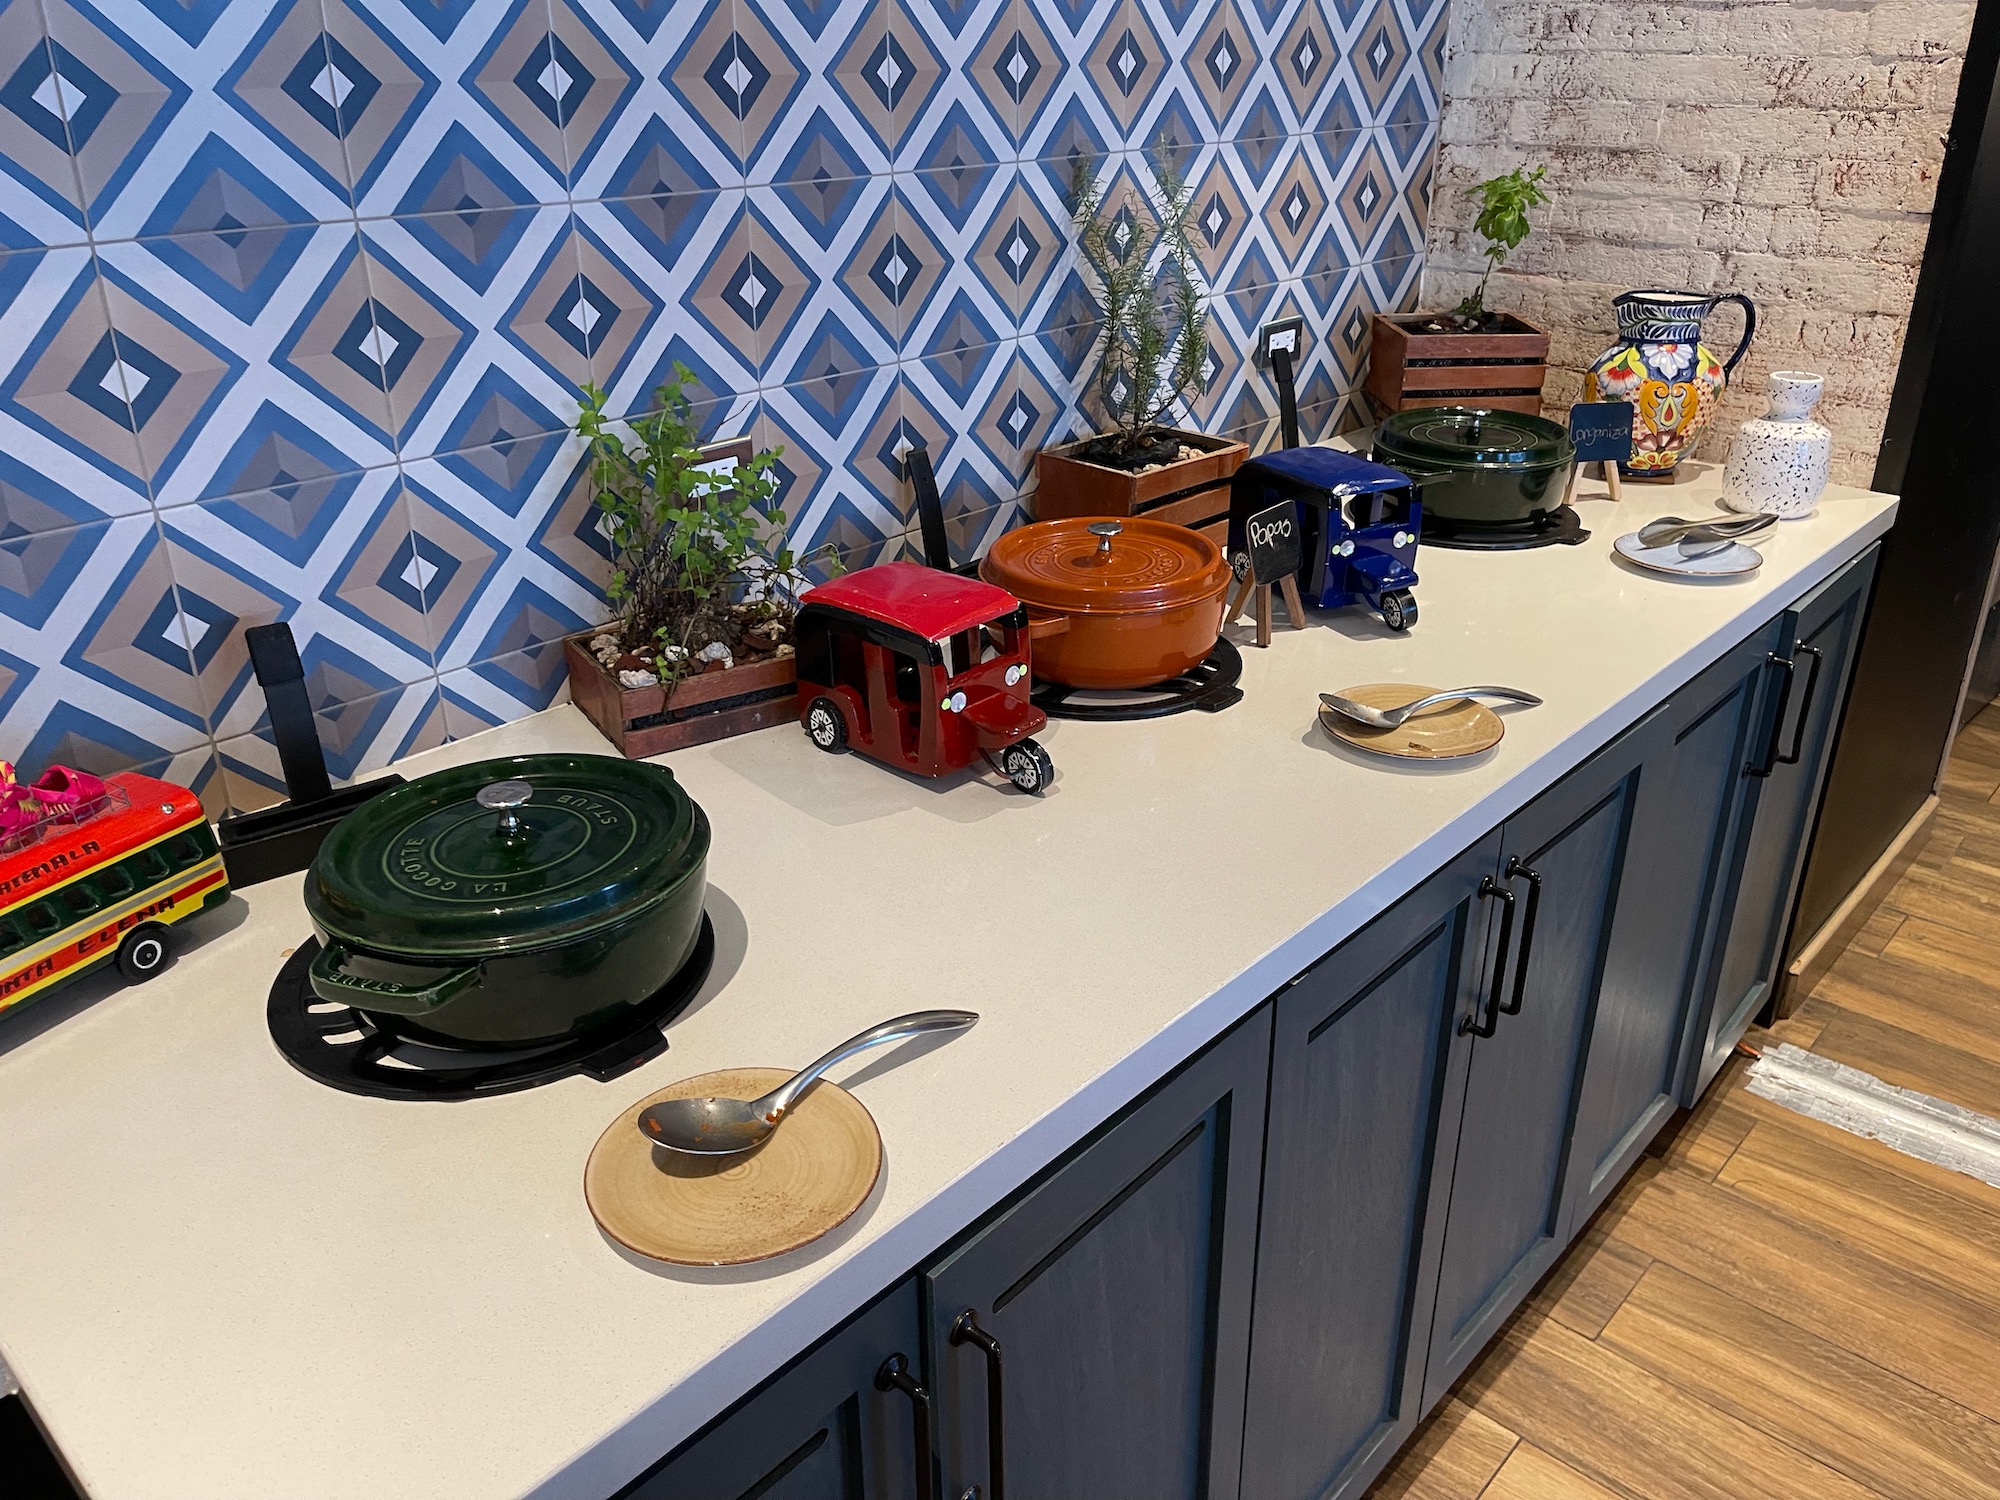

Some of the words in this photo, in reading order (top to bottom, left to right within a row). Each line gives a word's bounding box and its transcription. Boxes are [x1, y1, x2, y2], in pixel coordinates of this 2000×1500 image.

[1570, 420, 1629, 446] Longaniza
[556, 794, 618, 825] STAUB
[400, 837, 458, 892] COCOTTE
[474, 881, 508, 894] LA
[0, 957, 53, 997] NTA
[78, 896, 175, 953] ELENA
